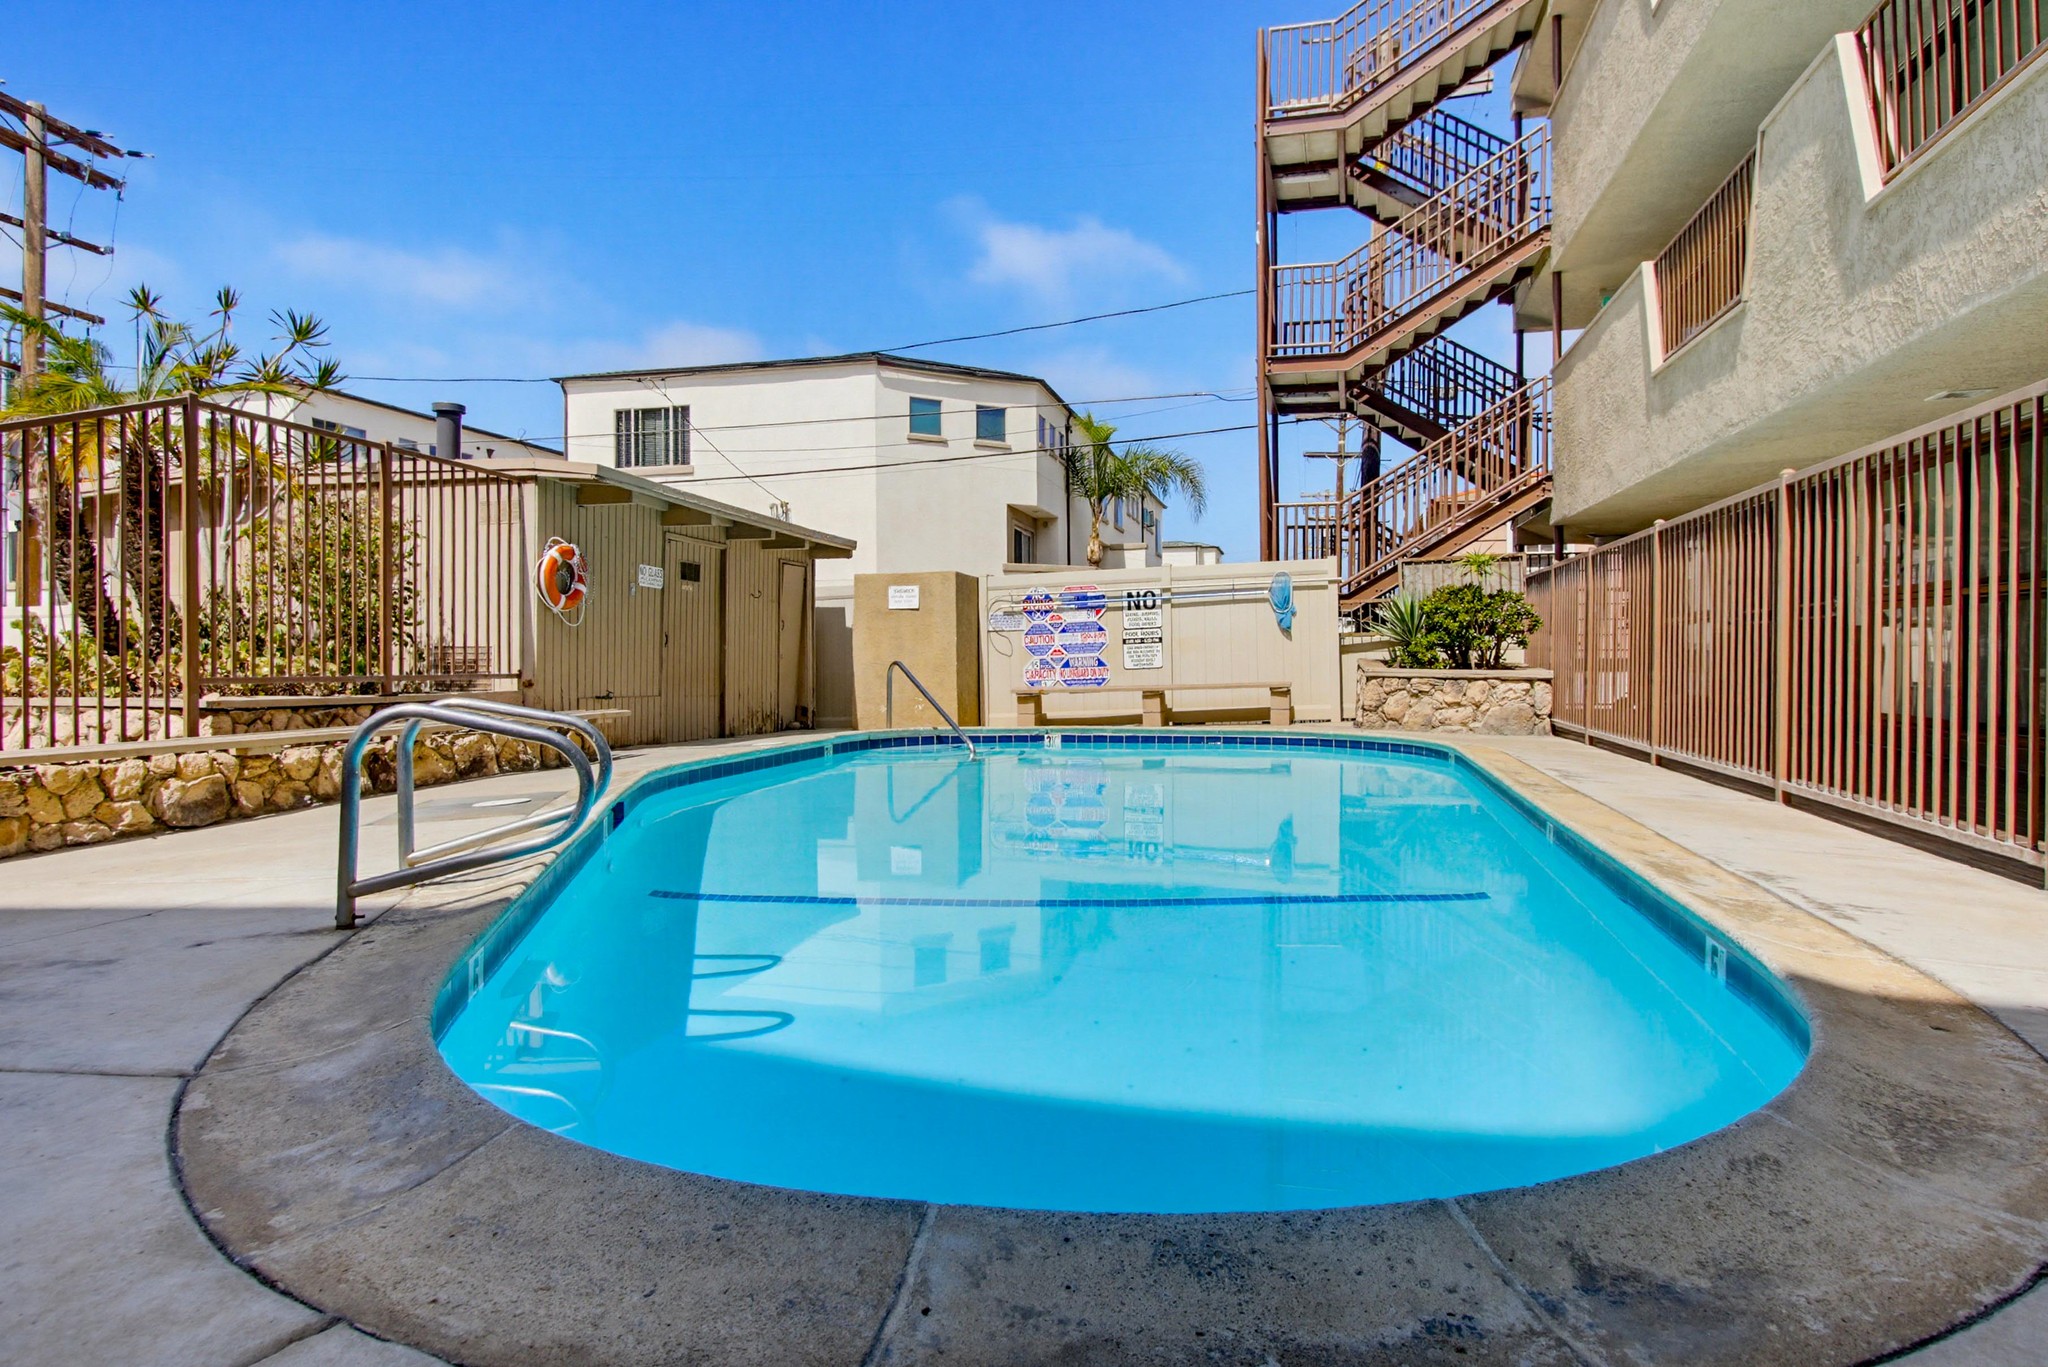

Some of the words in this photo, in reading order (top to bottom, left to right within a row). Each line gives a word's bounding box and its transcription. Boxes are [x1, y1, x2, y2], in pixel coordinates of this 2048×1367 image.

[648, 567, 663, 579] GLASS
[1127, 590, 1156, 611] NO
[1023, 634, 1055, 645] CAUTION
[1069, 656, 1099, 667] WARNING
[1025, 670, 1056, 680] CAPACITY
[1090, 668, 1097, 677] ON
[1098, 667, 1110, 677] DUTY
